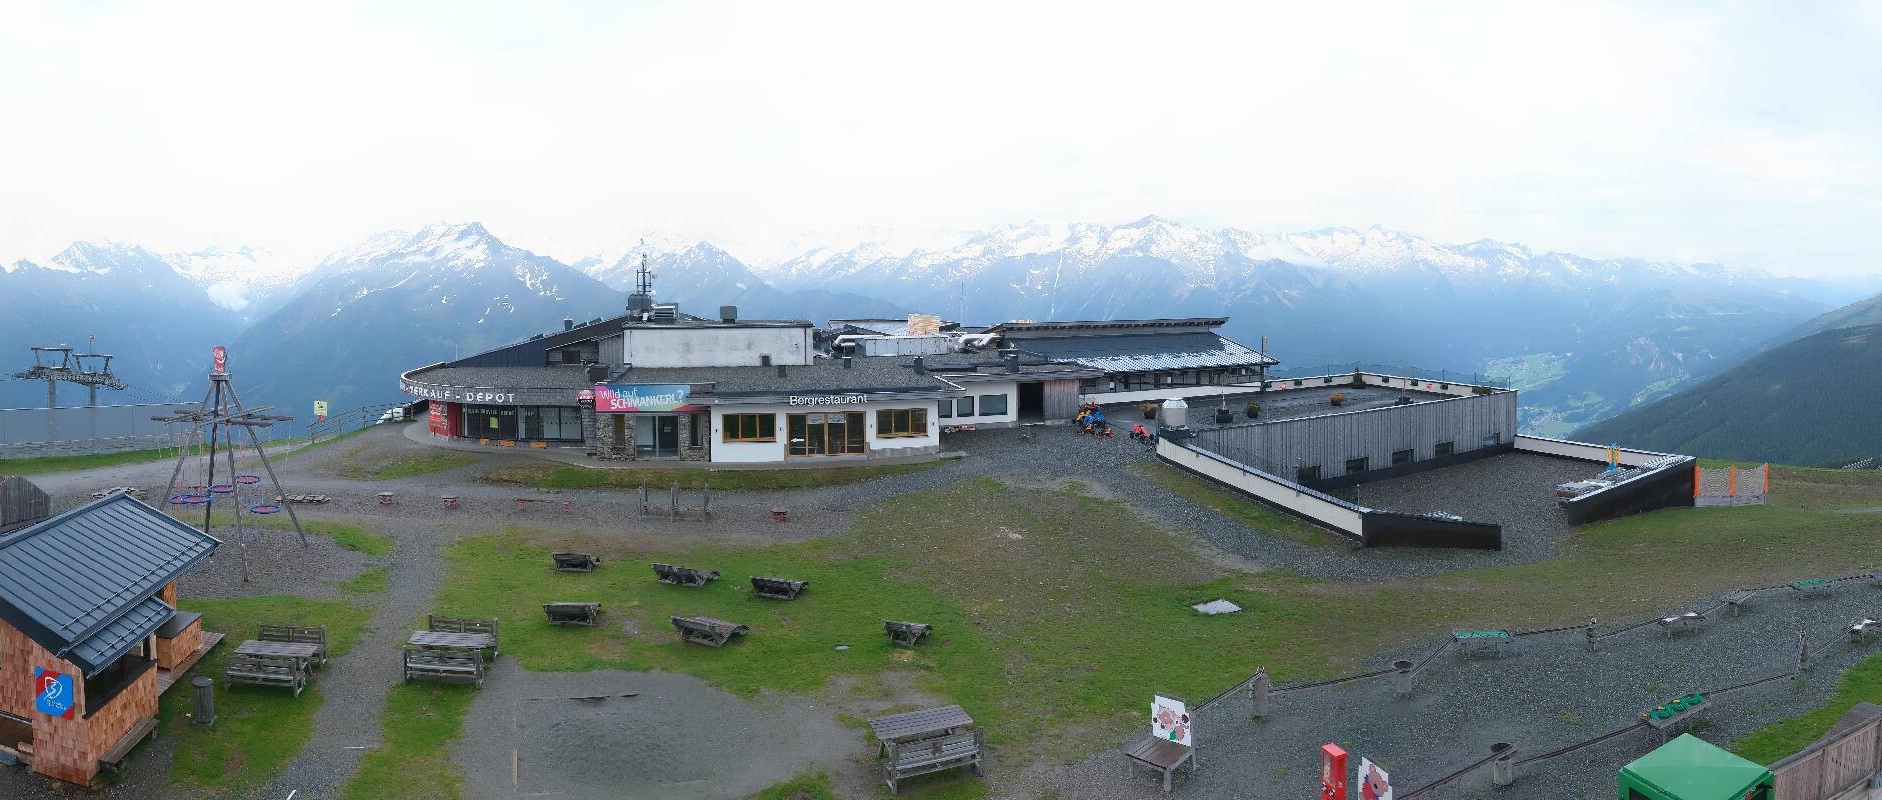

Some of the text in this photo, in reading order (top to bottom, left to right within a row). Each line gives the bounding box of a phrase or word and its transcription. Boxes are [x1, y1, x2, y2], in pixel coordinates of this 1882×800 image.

[600, 389, 620, 399] Wild
[622, 388, 637, 397] auf
[610, 390, 684, 409] SCHMANKERL?
[790, 394, 868, 407] Bergrestaurant
